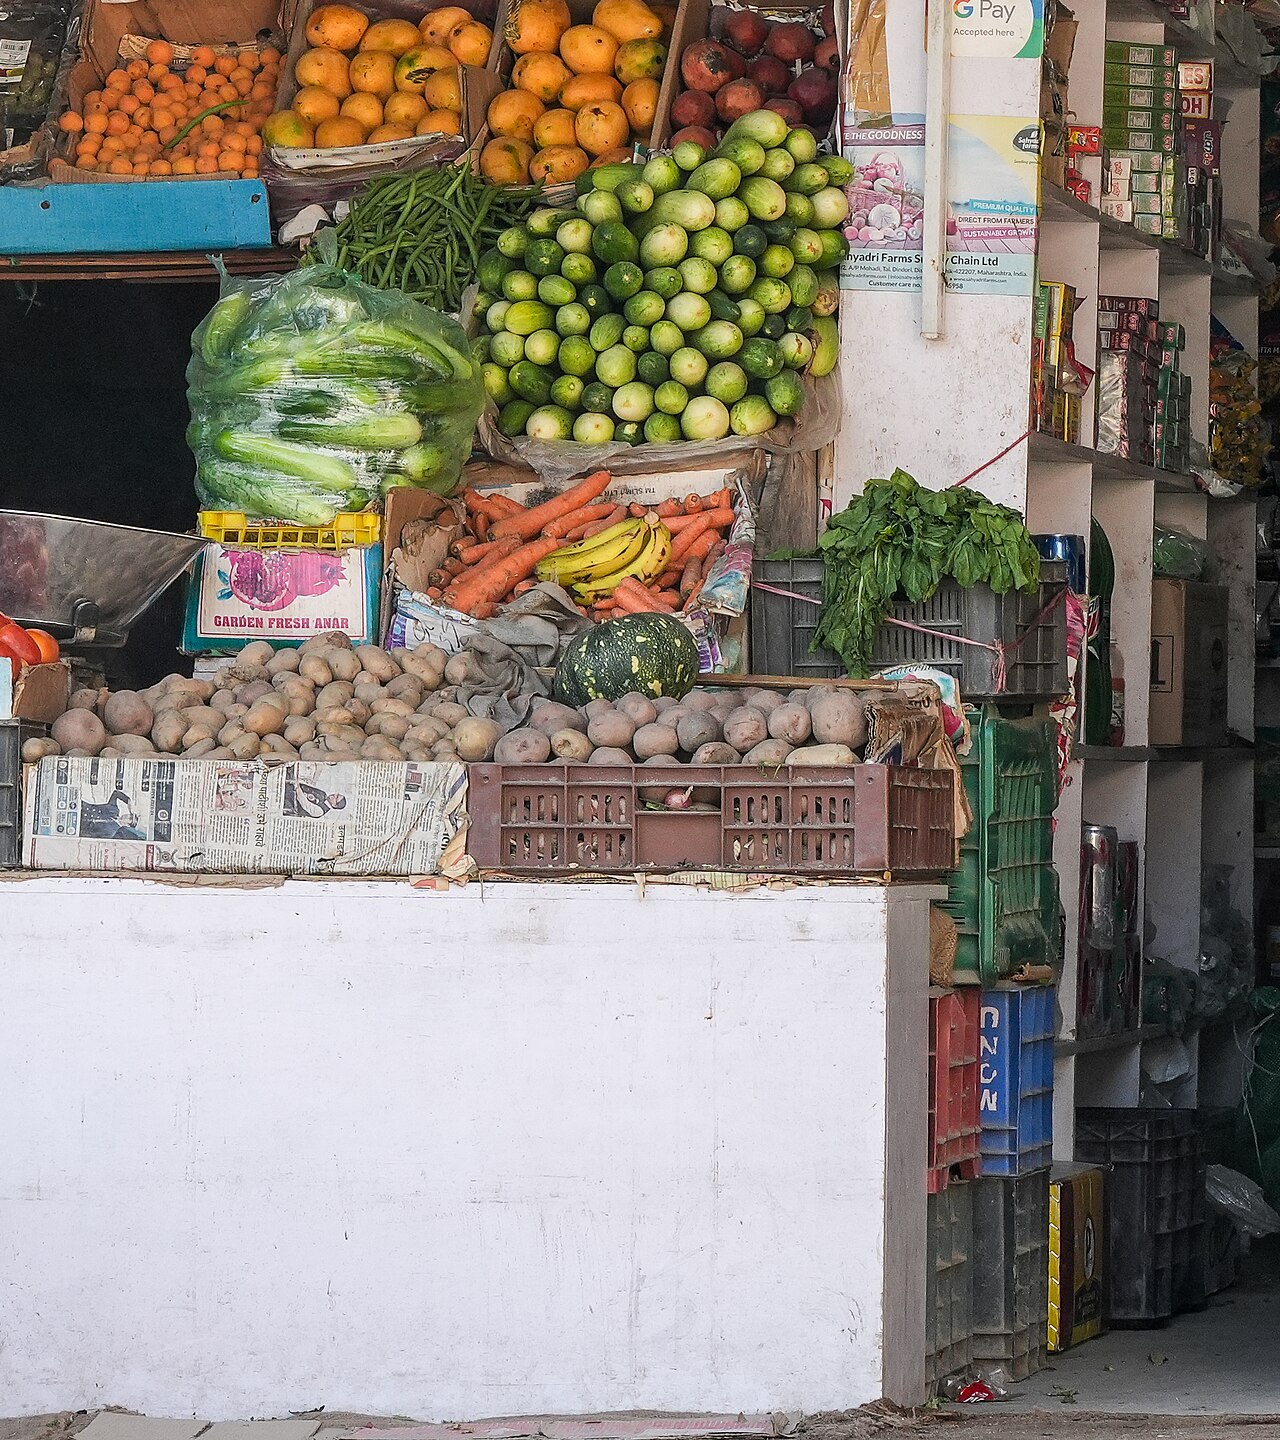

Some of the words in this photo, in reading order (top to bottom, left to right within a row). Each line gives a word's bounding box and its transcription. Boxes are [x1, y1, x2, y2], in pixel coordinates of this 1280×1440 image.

[980, 0, 1016, 24] Pay
[953, 28, 994, 37] Accepted
[996, 29, 1015, 37] here
[851, 132, 867, 140] THE
[868, 130, 922, 140] GOODNESS
[972, 201, 1005, 211] PREMIUM
[1005, 204, 1035, 213] QUALITY
[958, 216, 982, 224] DIRECT
[983, 216, 1003, 224] FROM
[1004, 217, 1035, 225] FARMERS
[963, 229, 1007, 238] SUSTAINABLY
[1007, 229, 1035, 237] GROWN
[881, 253, 913, 263] Farms
[951, 255, 980, 266] Chain
[982, 256, 999, 266] Ltd
[213, 615, 264, 629] GARDEN
[268, 616, 311, 629] FRESH
[315, 616, 350, 629] ANAR
